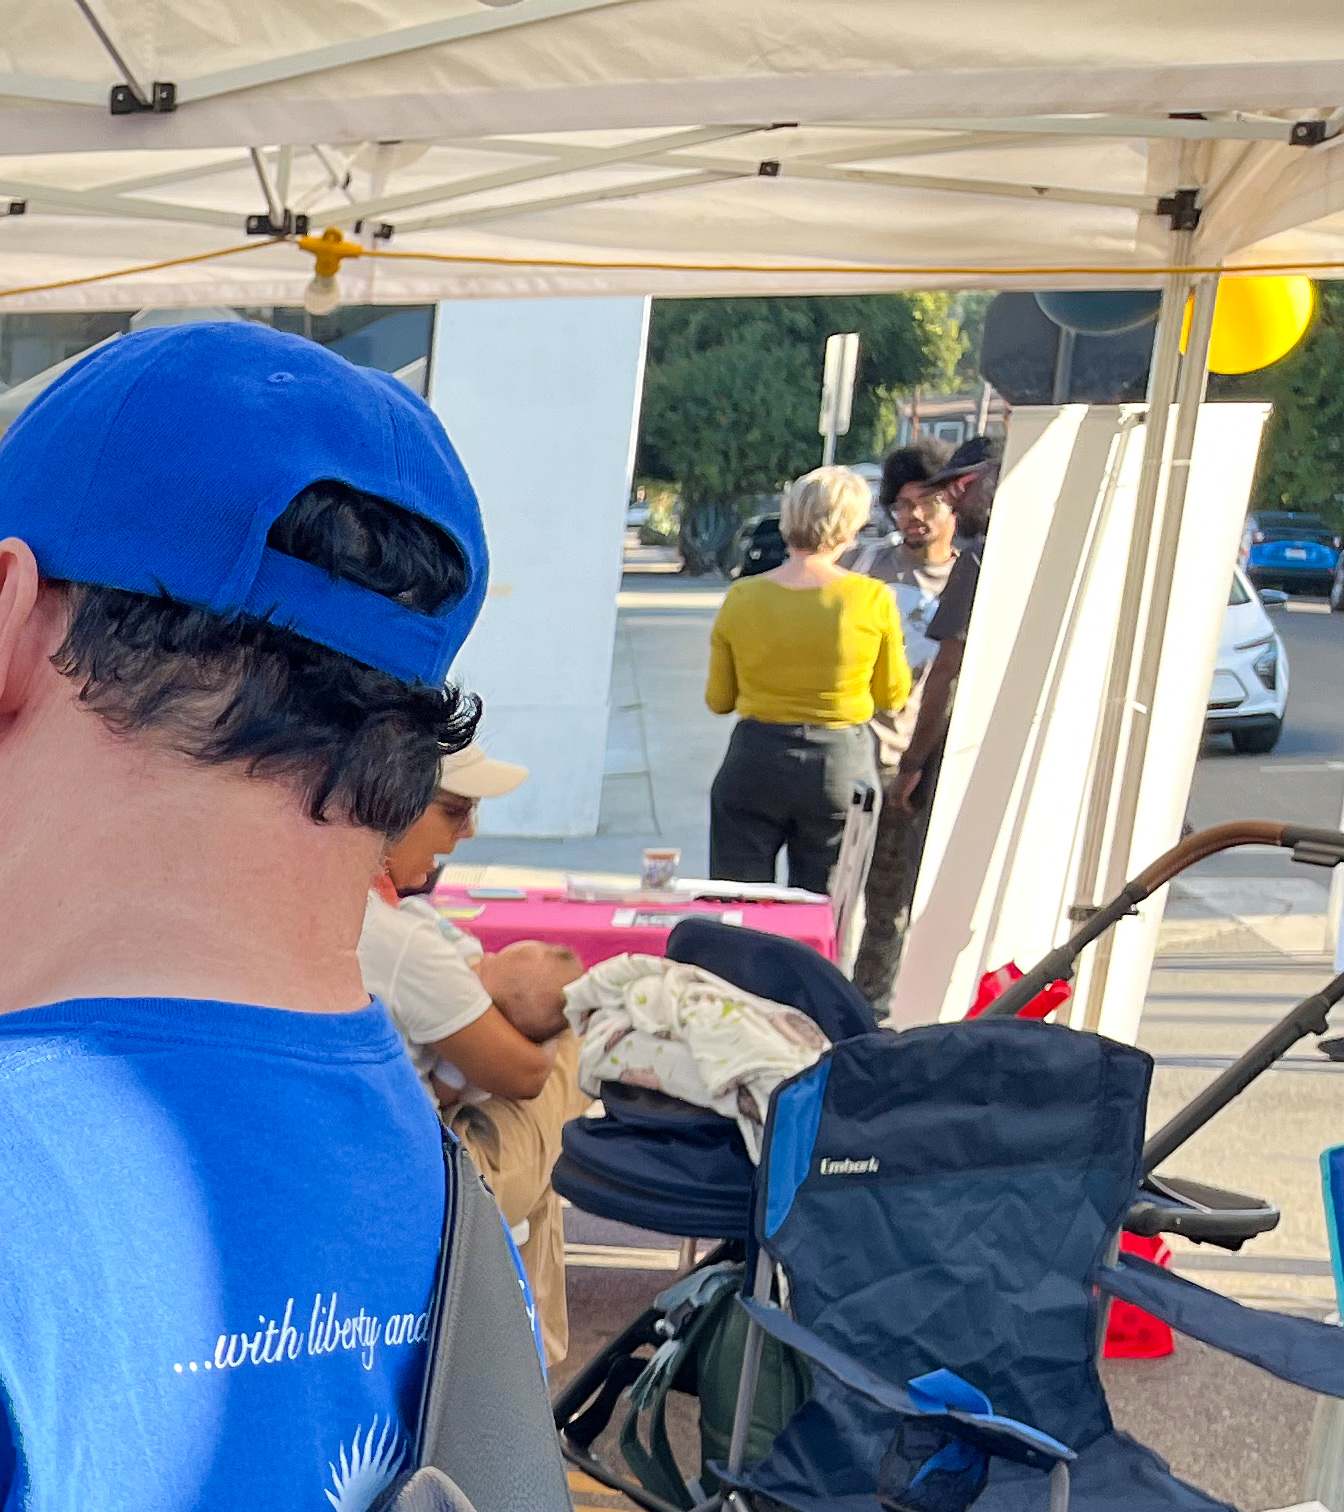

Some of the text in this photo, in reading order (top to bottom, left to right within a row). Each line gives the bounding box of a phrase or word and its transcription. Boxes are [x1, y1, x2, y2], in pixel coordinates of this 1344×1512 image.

[820, 1156, 880, 1175] Embark
[308, 1292, 381, 1371] liberty
[385, 1288, 434, 1346] and
